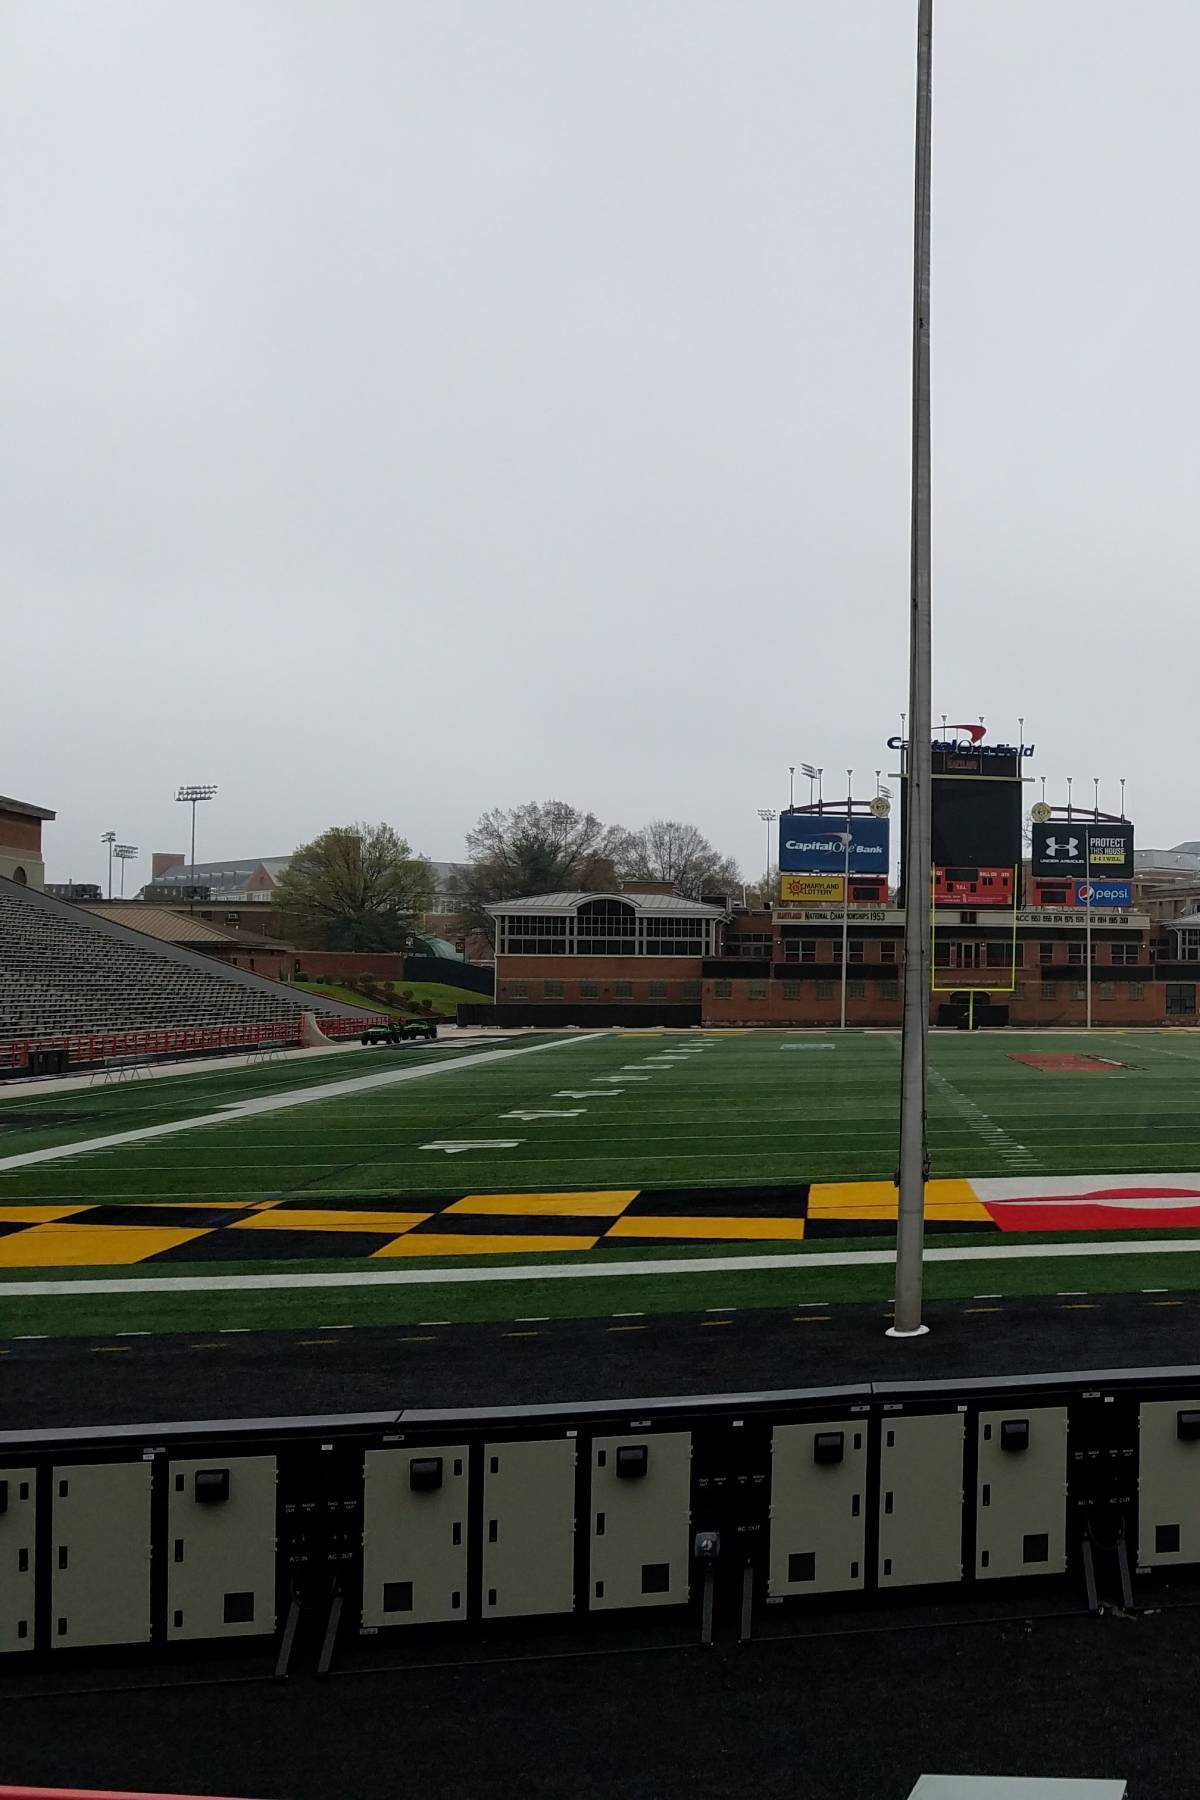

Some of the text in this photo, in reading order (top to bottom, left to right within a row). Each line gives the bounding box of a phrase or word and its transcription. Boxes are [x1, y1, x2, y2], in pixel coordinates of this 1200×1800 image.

[996, 744, 1035, 757] Field
[1090, 837, 1126, 847] PROTECT
[856, 845, 884, 854] Bank
[1090, 847, 1104, 855] THIS
[1096, 888, 1129, 900] pepsi
[870, 913, 885, 921] 1953
